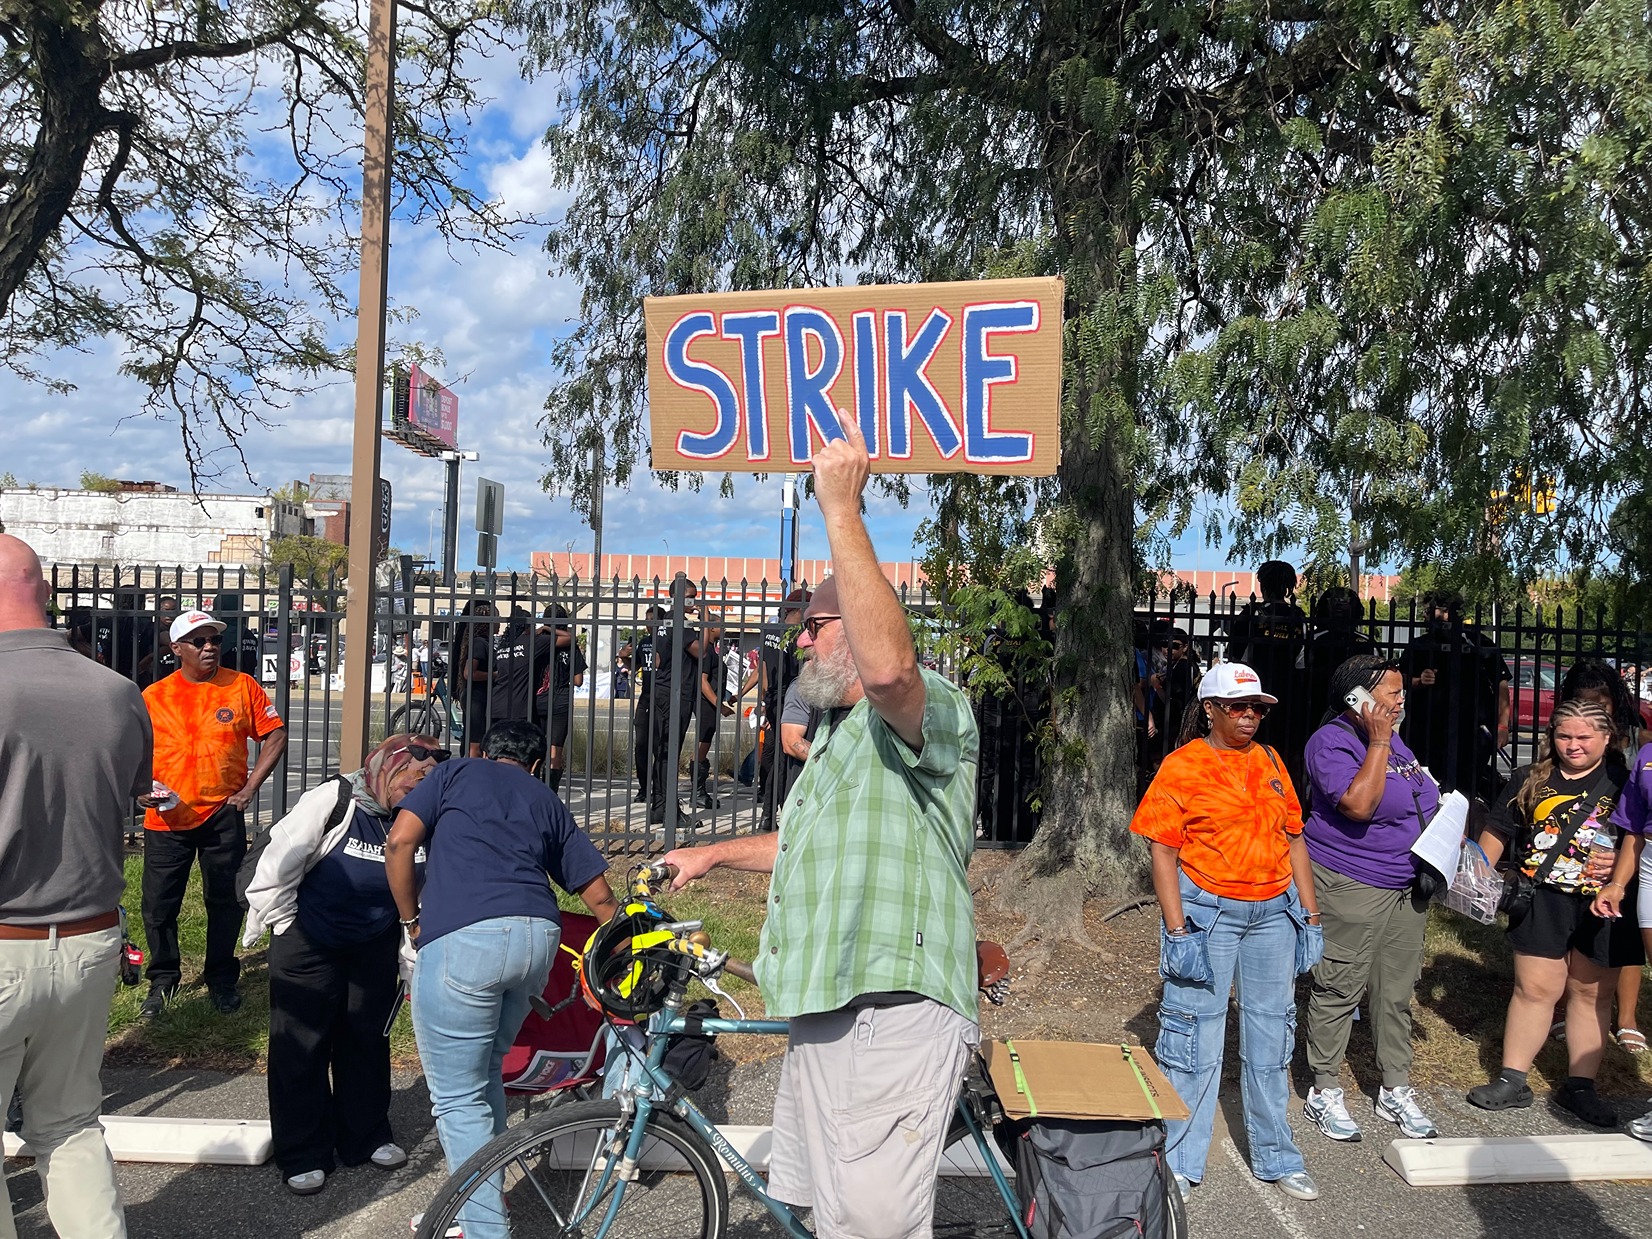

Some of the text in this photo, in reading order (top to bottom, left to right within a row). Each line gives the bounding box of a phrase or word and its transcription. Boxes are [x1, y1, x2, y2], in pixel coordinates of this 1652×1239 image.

[664, 300, 1041, 464] STRIKE
[346, 837, 383, 856] ISAIAH
[711, 1133, 757, 1188] Romulus
